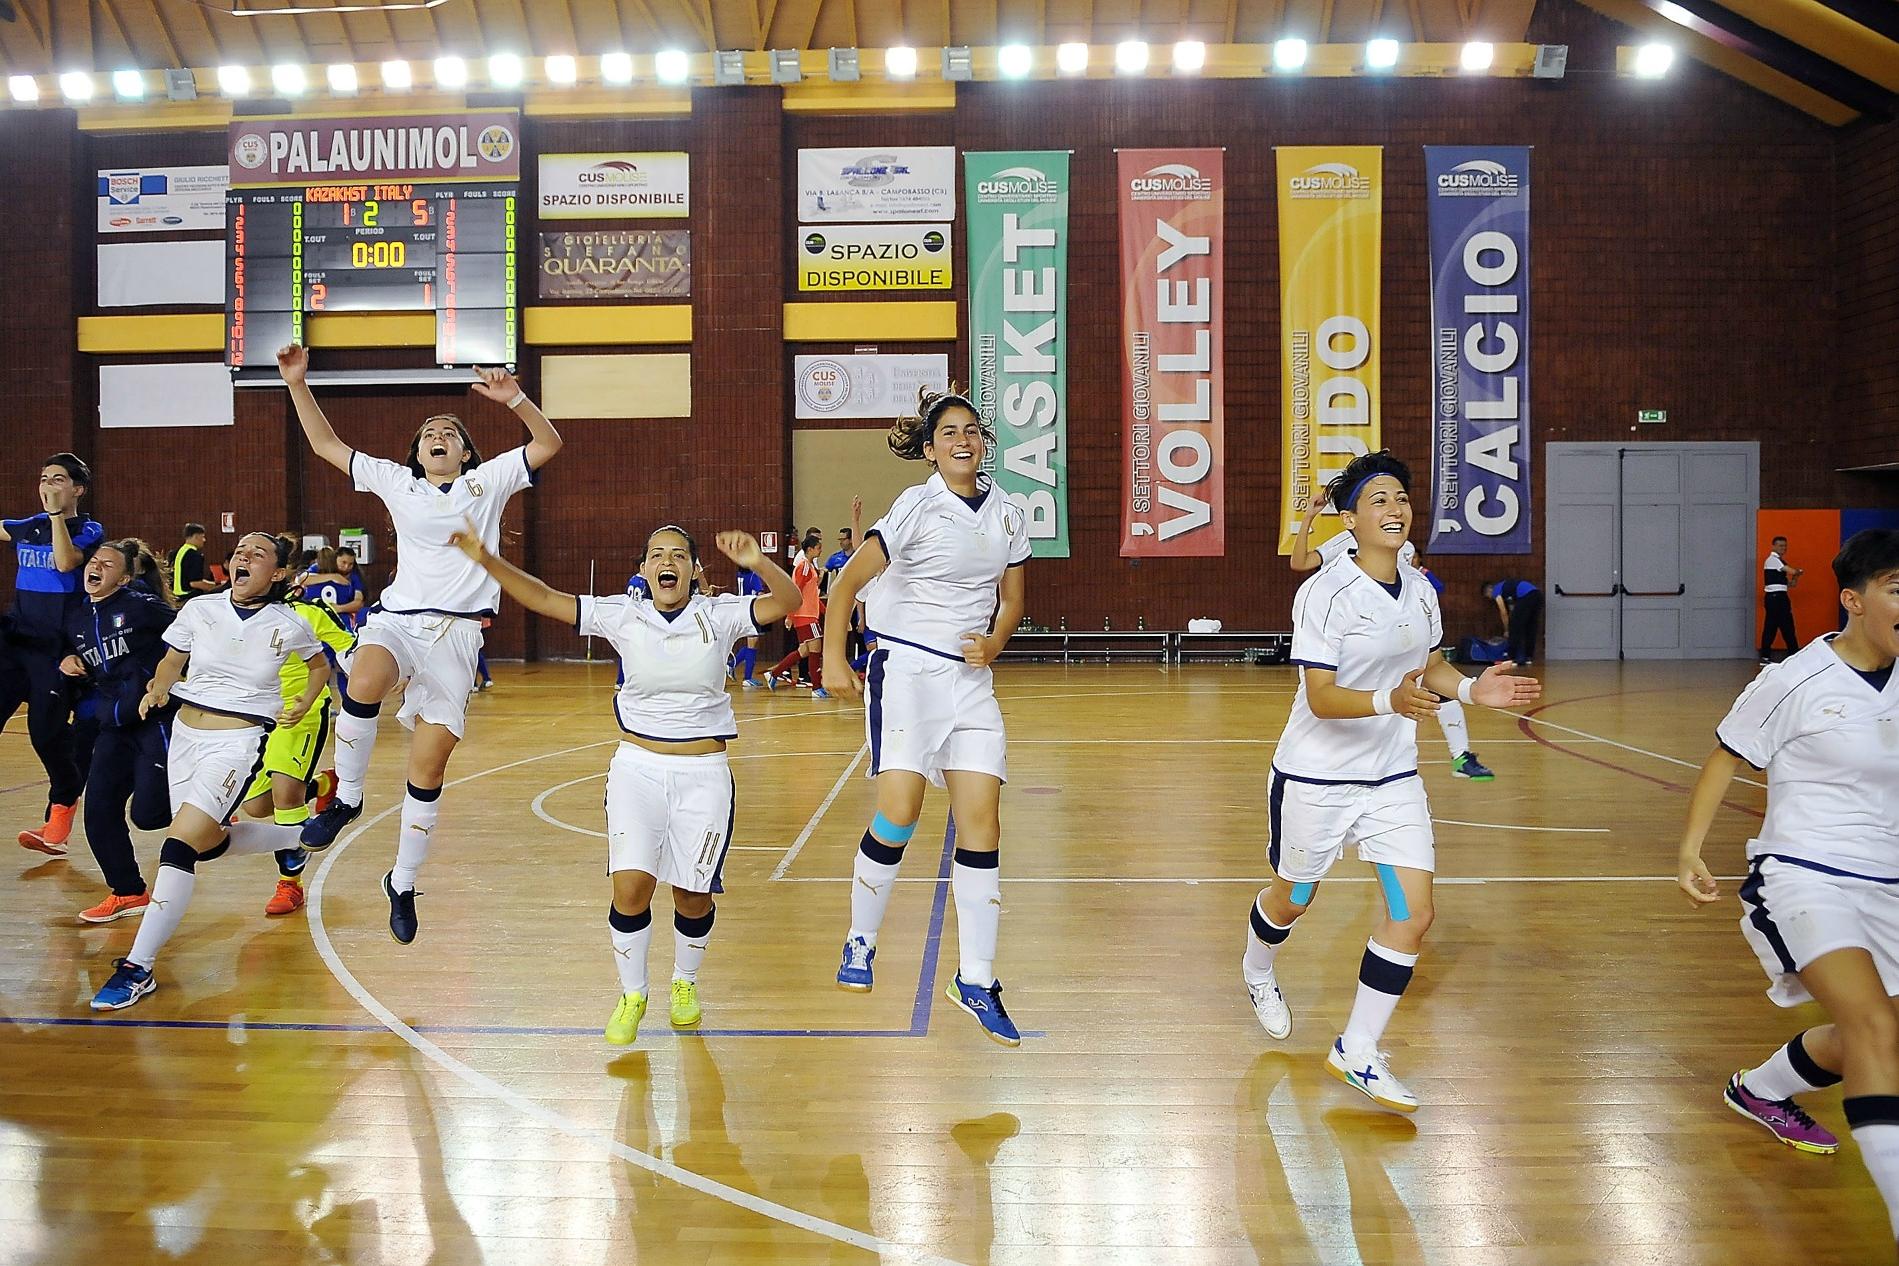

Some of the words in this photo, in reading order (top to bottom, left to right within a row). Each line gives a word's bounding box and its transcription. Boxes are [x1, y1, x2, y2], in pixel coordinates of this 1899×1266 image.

[269, 126, 478, 173] PALAUNIMOL
[111, 178, 138, 186] BOSCH
[252, 195, 275, 203] FOULS
[281, 195, 303, 203] SCORE
[374, 185, 412, 200] ITALY
[463, 190, 487, 198] FOULS
[493, 190, 516, 198] SCORE
[543, 194, 592, 206] SPAZIO
[596, 192, 685, 205] DISPONIBILE
[881, 187, 931, 196] CAMPOBASSO
[293, 202, 302, 215] 0
[505, 198, 514, 210] 0
[343, 202, 351, 225] 1
[363, 201, 379, 226] 2
[412, 200, 429, 226] 5
[446, 212, 456, 226] 2
[505, 211, 514, 224] 0
[235, 216, 244, 230] 2
[293, 216, 302, 228] 0
[236, 230, 244, 244] 3
[293, 229, 302, 242] 0
[446, 226, 456, 239] 3
[505, 225, 514, 238] 0
[446, 240, 456, 252] 4
[505, 239, 514, 252] 0
[563, 234, 663, 246] GIOIELLERIA
[235, 244, 244, 256] 4
[293, 242, 302, 256] 0
[352, 241, 405, 268] 0:00
[543, 245, 687, 258] STEFANO
[831, 243, 919, 260] SPAZIO
[235, 258, 244, 271] 5
[293, 256, 302, 270] 0
[446, 253, 456, 267] 5
[505, 253, 514, 266] 0
[543, 256, 686, 276] QUARANTA
[235, 271, 244, 284] 6
[293, 270, 302, 284] 0
[446, 267, 456, 280] 6
[505, 267, 514, 280] 0
[807, 269, 943, 287] DISPONIBILE
[236, 284, 244, 297] 7
[293, 284, 302, 296] 0
[424, 283, 431, 304] 1
[446, 280, 456, 294] 7
[505, 280, 514, 294] 0
[293, 297, 302, 310] 0
[310, 284, 328, 310] 2
[505, 294, 514, 307] 0
[235, 311, 244, 326] 9
[293, 311, 302, 324] 0
[505, 308, 514, 322] 0
[505, 322, 514, 335] 0
[812, 371, 836, 381] CUS
[979, 334, 996, 420] GIOVANILI
[1003, 213, 1057, 539] BASKET
[1132, 332, 1151, 420] GIOVANILI
[1292, 331, 1310, 420] GIOVANILI
[1440, 328, 1458, 416] GIOVANILI
[1157, 218, 1212, 542] VOLLEY
[1463, 231, 1519, 536] CALCIO
[1132, 423, 1151, 513] SETTORI
[1292, 423, 1310, 512] SETTORI
[1440, 420, 1458, 510] SETTORI
[465, 477, 484, 498] 6
[20, 548, 57, 570] ITALIA
[269, 628, 284, 657] 4
[82, 636, 130, 667] ITALIA
[302, 733, 311, 757] 1
[222, 769, 237, 798] 4
[698, 831, 721, 866] 11
